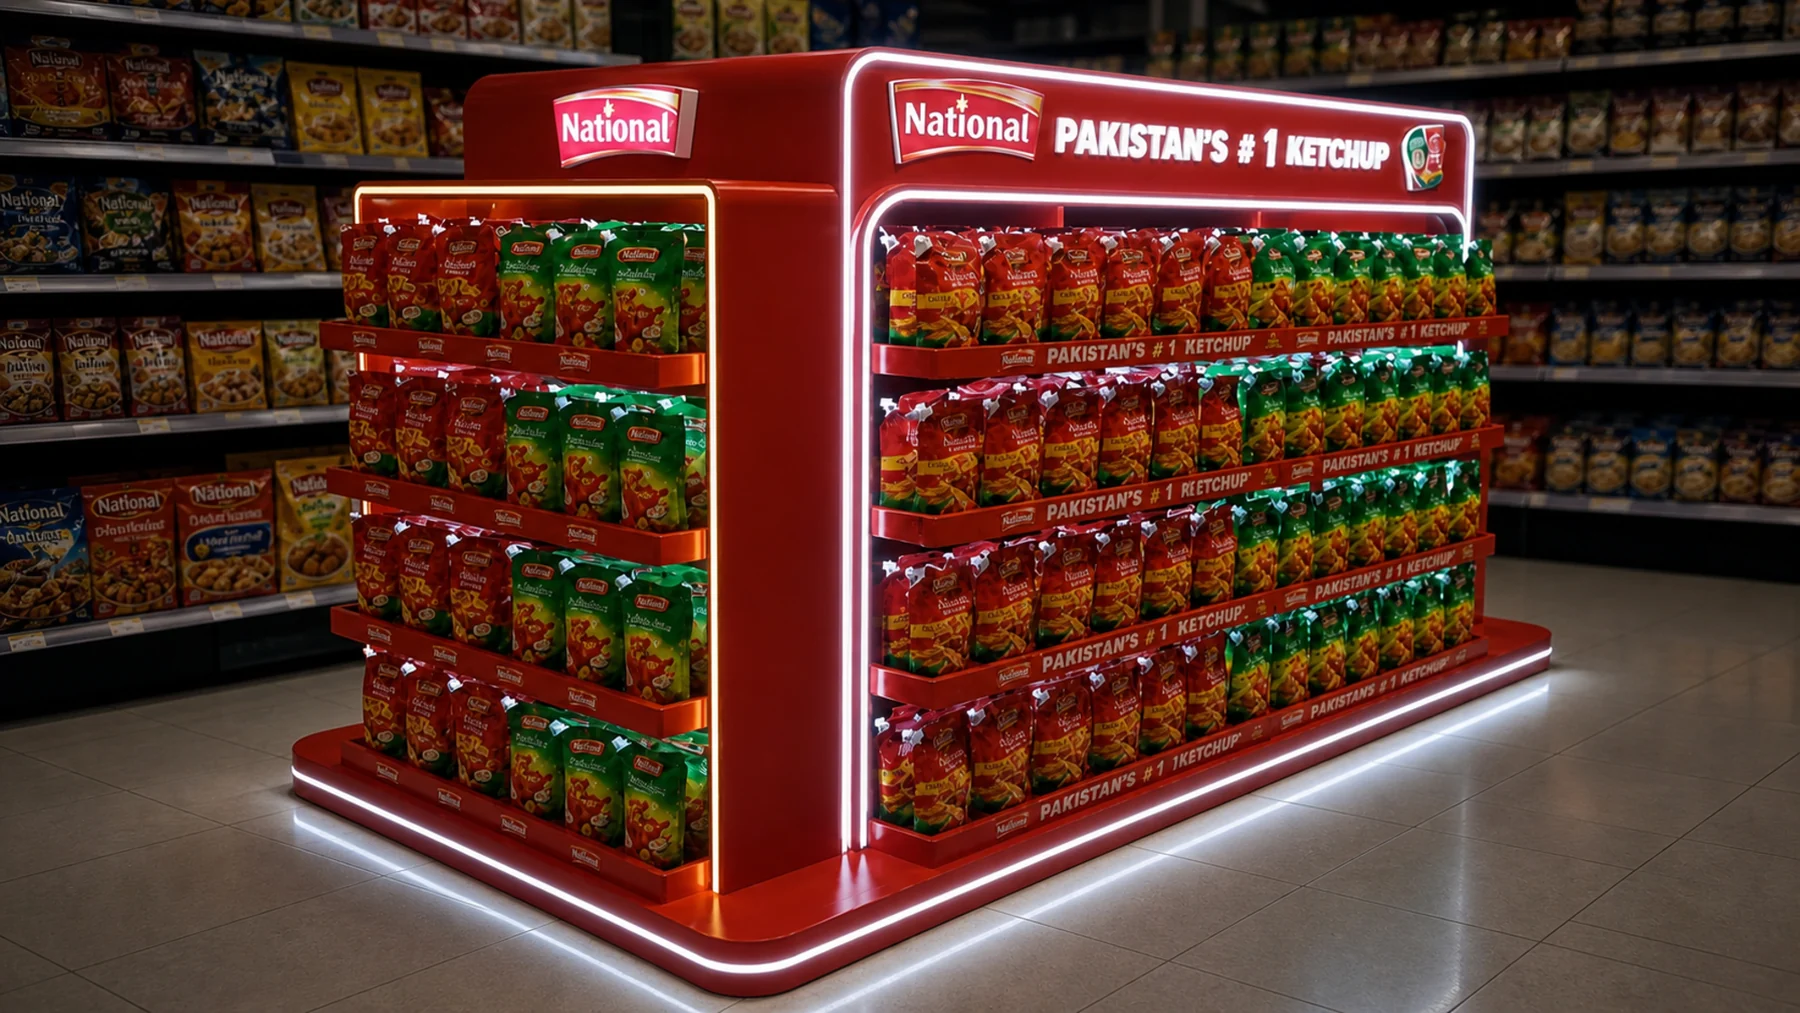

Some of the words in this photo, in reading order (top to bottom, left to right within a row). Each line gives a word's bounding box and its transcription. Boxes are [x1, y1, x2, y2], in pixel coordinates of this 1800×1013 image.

[561, 107, 670, 143] National
[904, 97, 1030, 144] National
[1054, 117, 1229, 165] PAKISTAN'S
[1237, 133, 1255, 164] #
[1263, 129, 1278, 169] 1
[1285, 135, 1391, 171] KETCHUP
[1047, 342, 1145, 364] PAKISTAN'S
[1152, 343, 1164, 358] #
[1168, 340, 1177, 356] 1
[1327, 327, 1395, 344] PAKISTAN'S
[1410, 324, 1416, 338] 1
[1322, 449, 1388, 473] PAKISTAN'S
[1404, 445, 1410, 459] 1
[98, 491, 161, 514] National
[194, 481, 257, 502] National
[1047, 490, 1143, 521] PAKISTAN'S
[1150, 488, 1160, 504] #
[1166, 483, 1173, 500] 1
[1042, 633, 1139, 672] PAKISTAN'S
[1145, 628, 1155, 646] #
[1160, 623, 1167, 641] 1
[1040, 771, 1136, 820] PAKISTAN'S
[1142, 766, 1152, 782] #
[1157, 760, 1164, 777] 1
